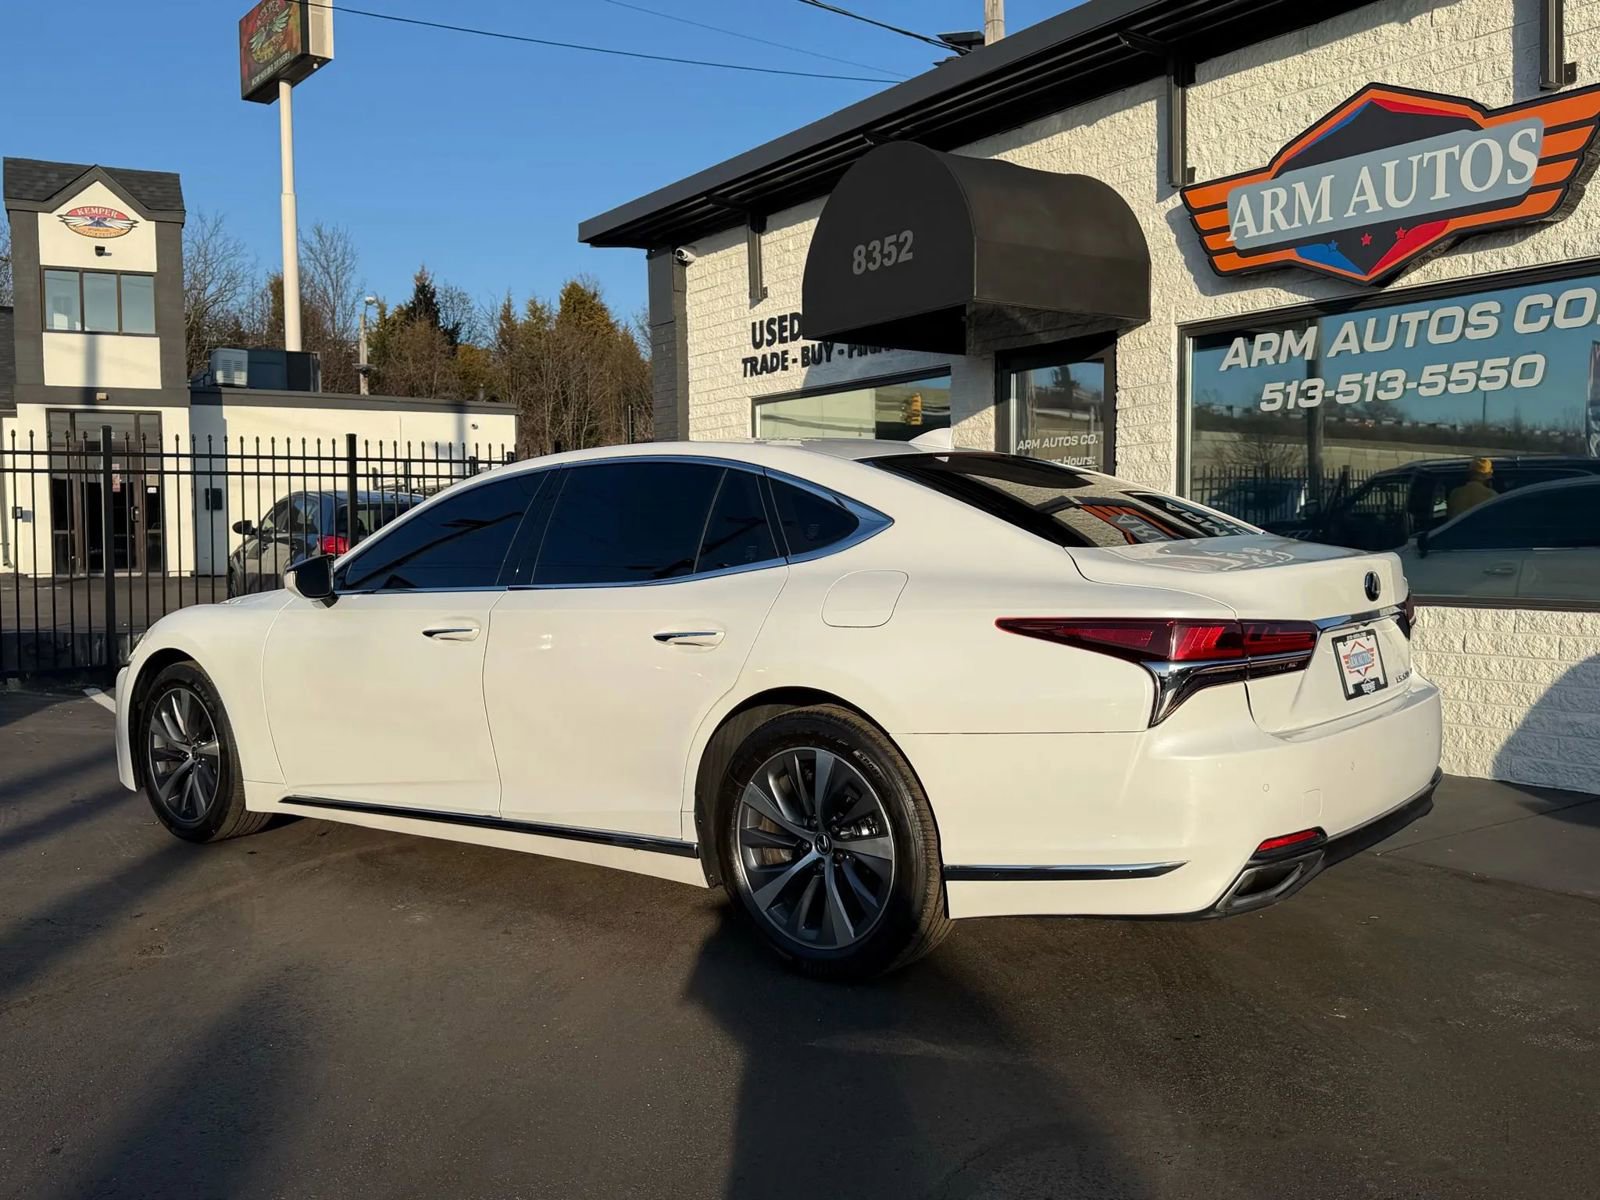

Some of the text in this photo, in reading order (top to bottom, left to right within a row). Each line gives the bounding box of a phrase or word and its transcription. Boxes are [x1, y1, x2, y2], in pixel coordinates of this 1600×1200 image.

[1226, 127, 1538, 242] ARM AUTOS
[76, 207, 118, 218] KEMPER
[852, 229, 914, 276] 8352
[751, 312, 803, 350] USED
[1219, 326, 1319, 372] ARM
[1327, 301, 1502, 358] AUTOS
[742, 349, 789, 378] TRADE
[800, 340, 834, 369] BUY
[1259, 353, 1547, 413] 513-513-5550
[1016, 433, 1099, 451] ARM AUTOS CO.
[1063, 455, 1097, 467] Hours:
